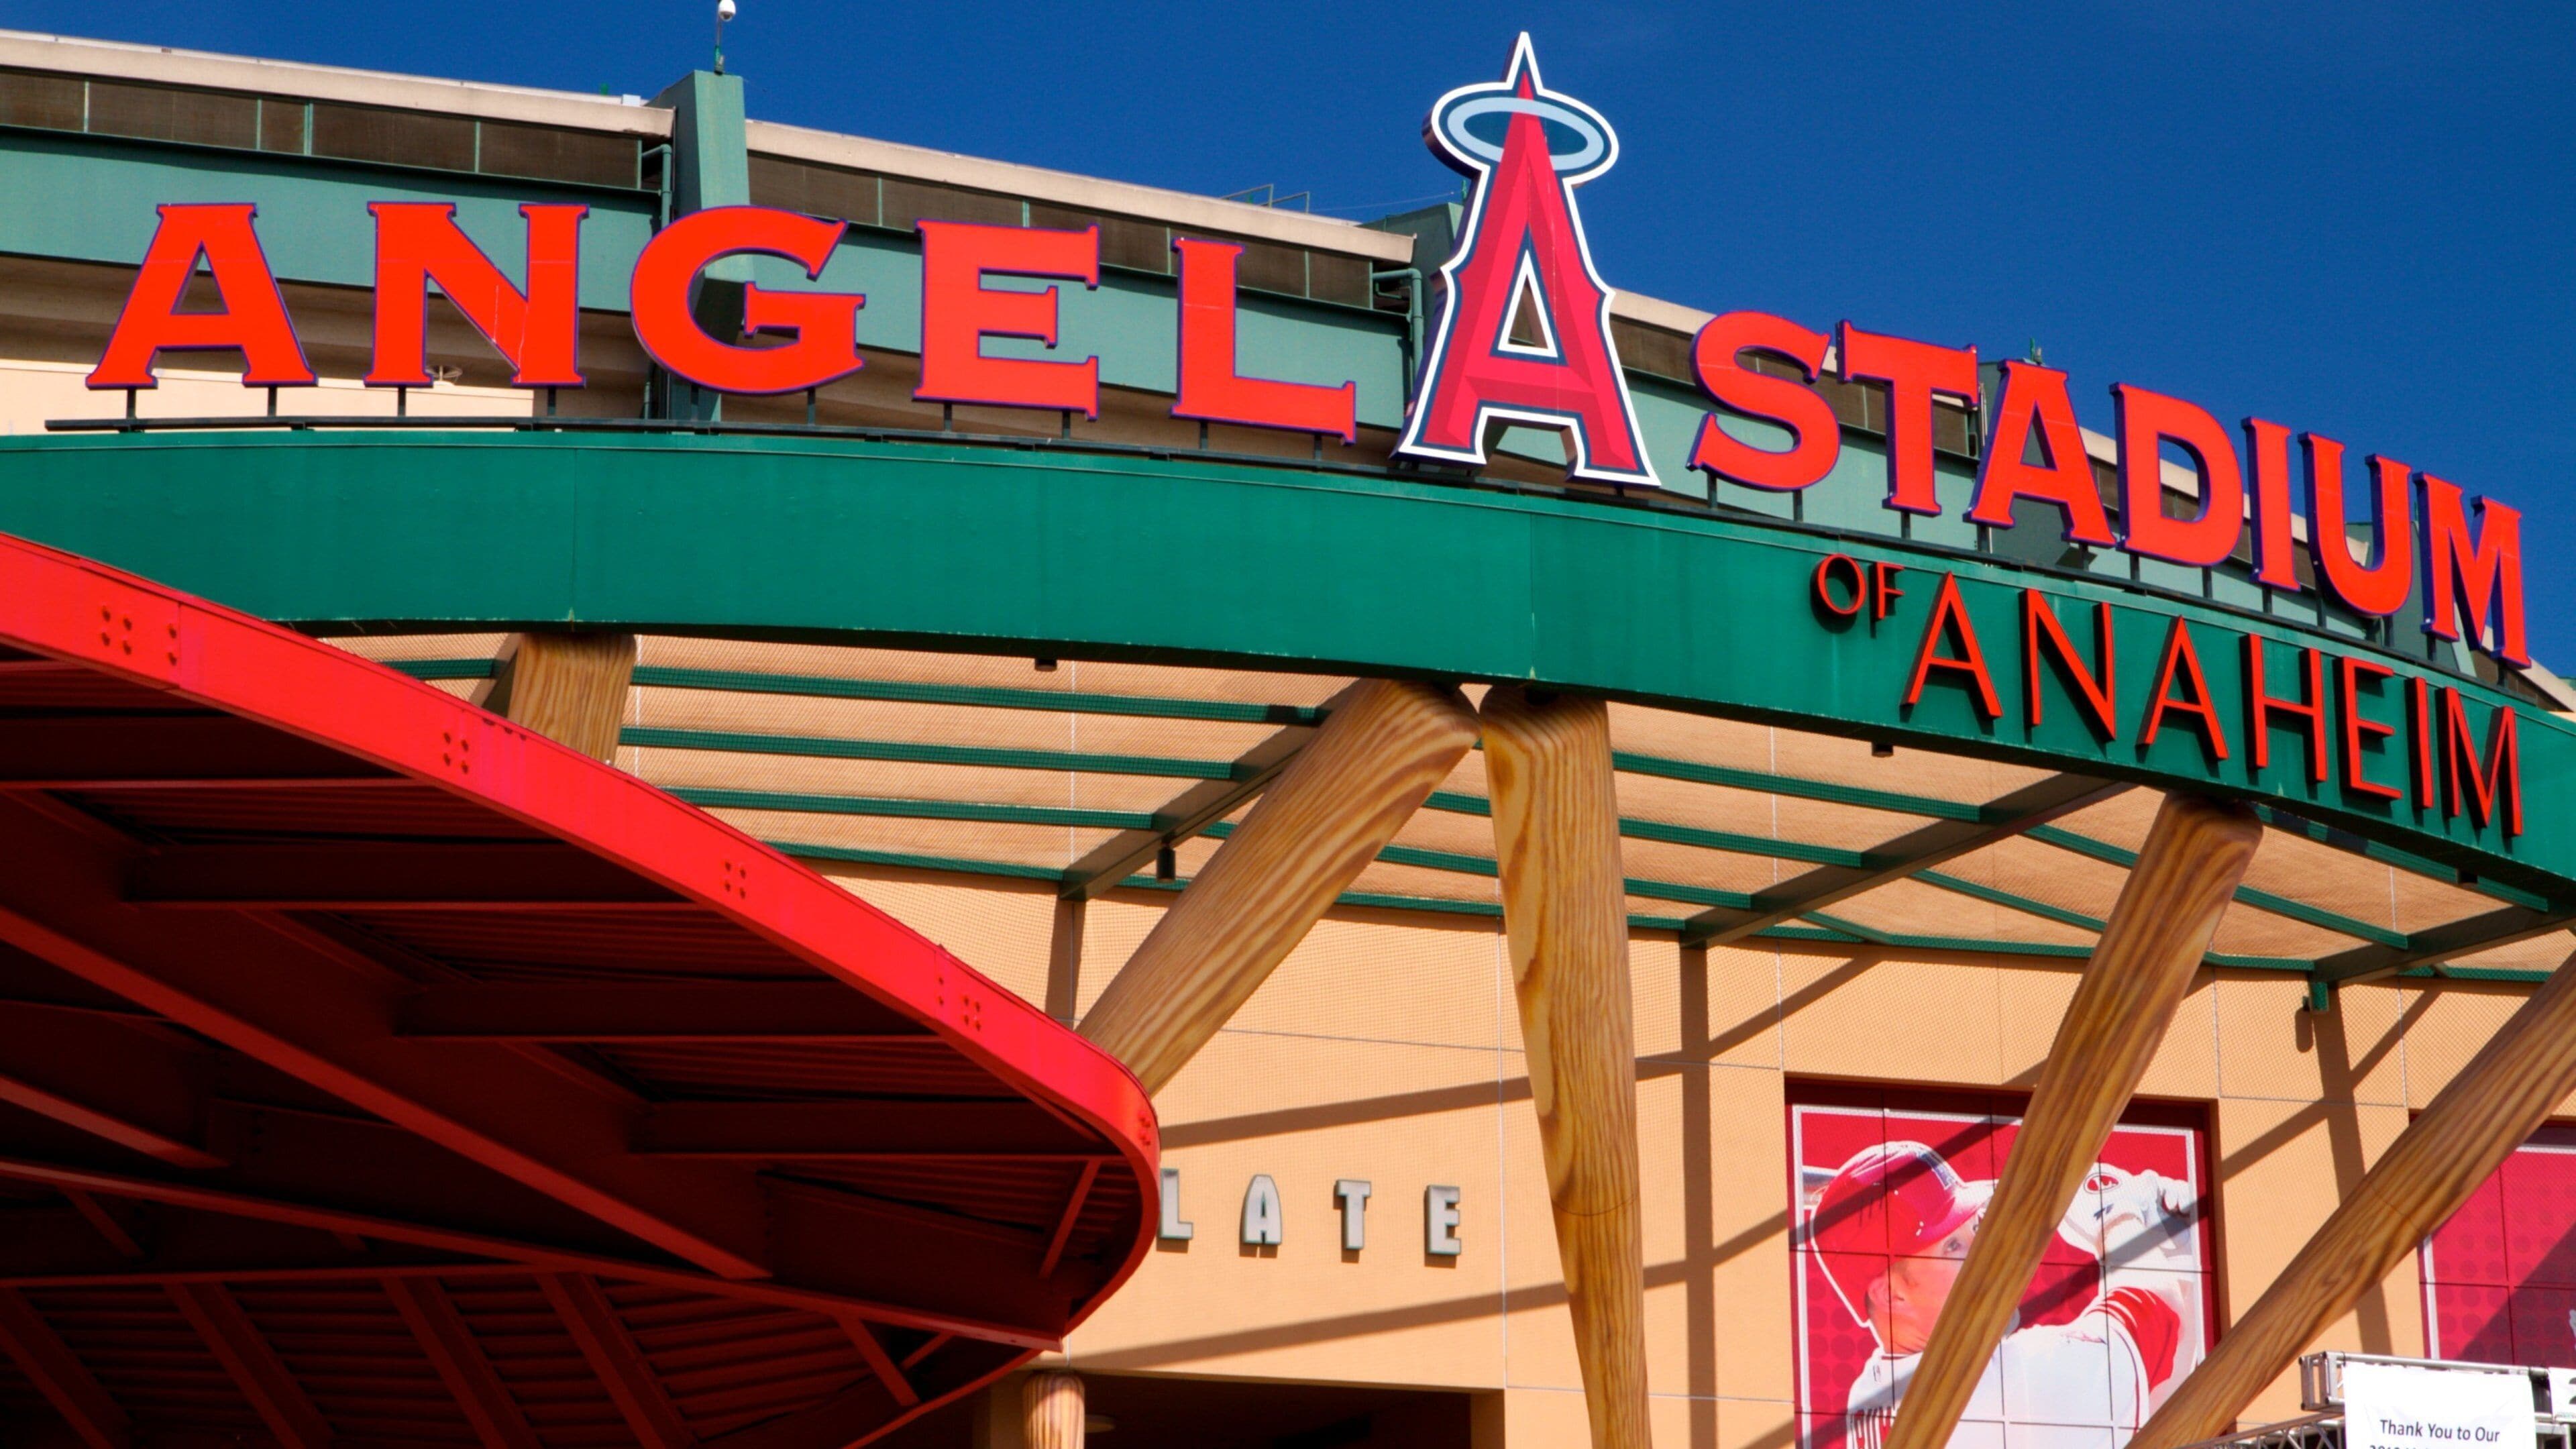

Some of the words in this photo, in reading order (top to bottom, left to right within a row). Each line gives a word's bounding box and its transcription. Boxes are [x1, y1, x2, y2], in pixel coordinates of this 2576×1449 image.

[85, 202, 1357, 444] ANGEL
[1394, 30, 1661, 488] A
[1688, 310, 2533, 668] STADIUM
[1813, 552, 1905, 621] OF
[1902, 570, 2524, 839] ANAHEIM
[2379, 1419, 2423, 1438] Thank
[2427, 1423, 2453, 1440] You
[2457, 1426, 2471, 1441] to
[2475, 1426, 2501, 1443] Our
